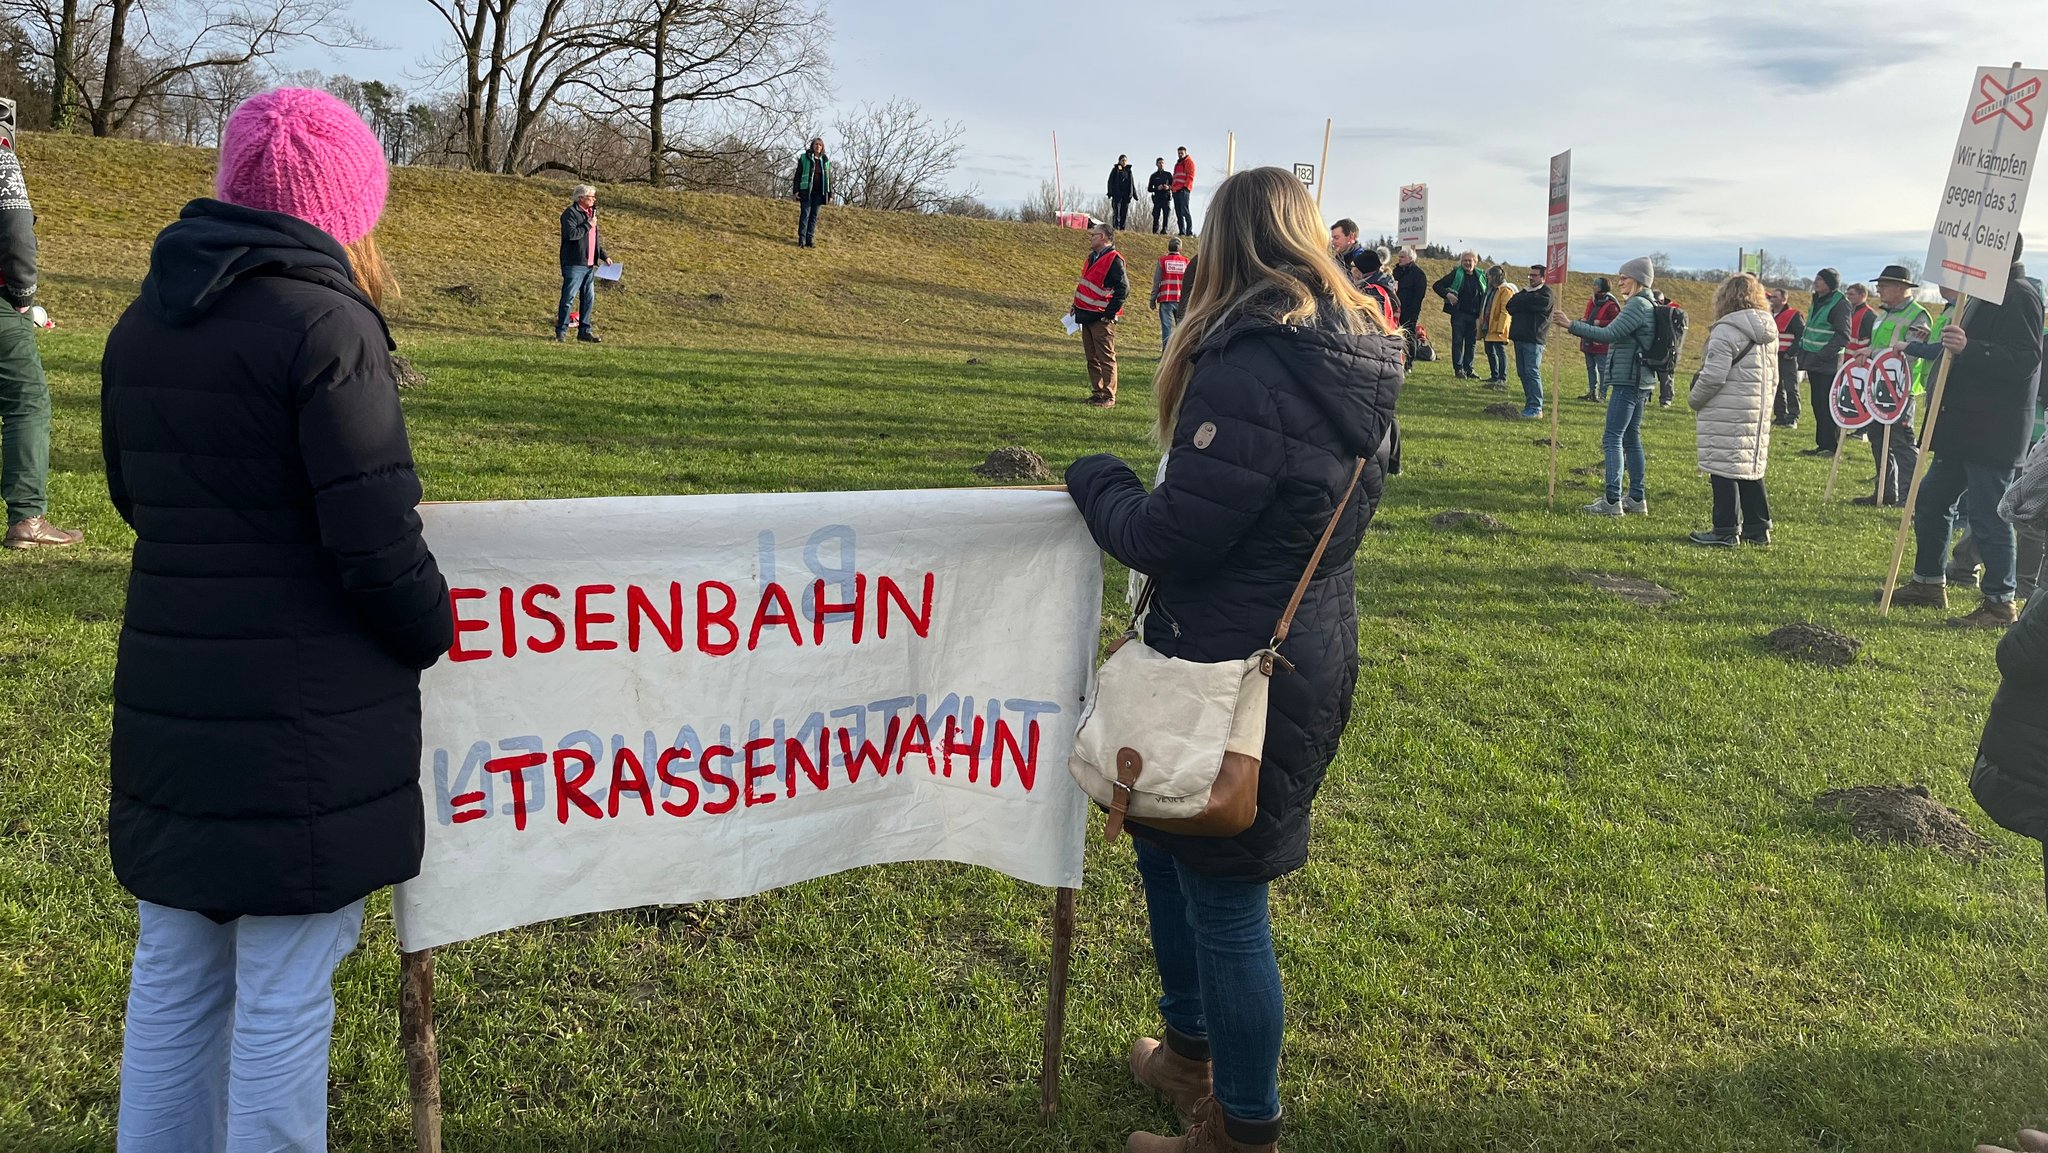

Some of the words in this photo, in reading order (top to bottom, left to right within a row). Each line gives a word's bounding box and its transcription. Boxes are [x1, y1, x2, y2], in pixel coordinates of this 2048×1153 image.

[1297, 168, 1312, 180] 182
[1957, 145, 1976, 166] Wir
[1976, 148, 2027, 177] kämpfen
[1946, 185, 1982, 207] gegen
[1984, 188, 2006, 210] das
[2007, 192, 2017, 214] 3.
[1938, 219, 1961, 239] und
[1961, 221, 1971, 242] 4.
[1975, 224, 2010, 251] Gleis!
[448, 571, 935, 663] EISENBAHN
